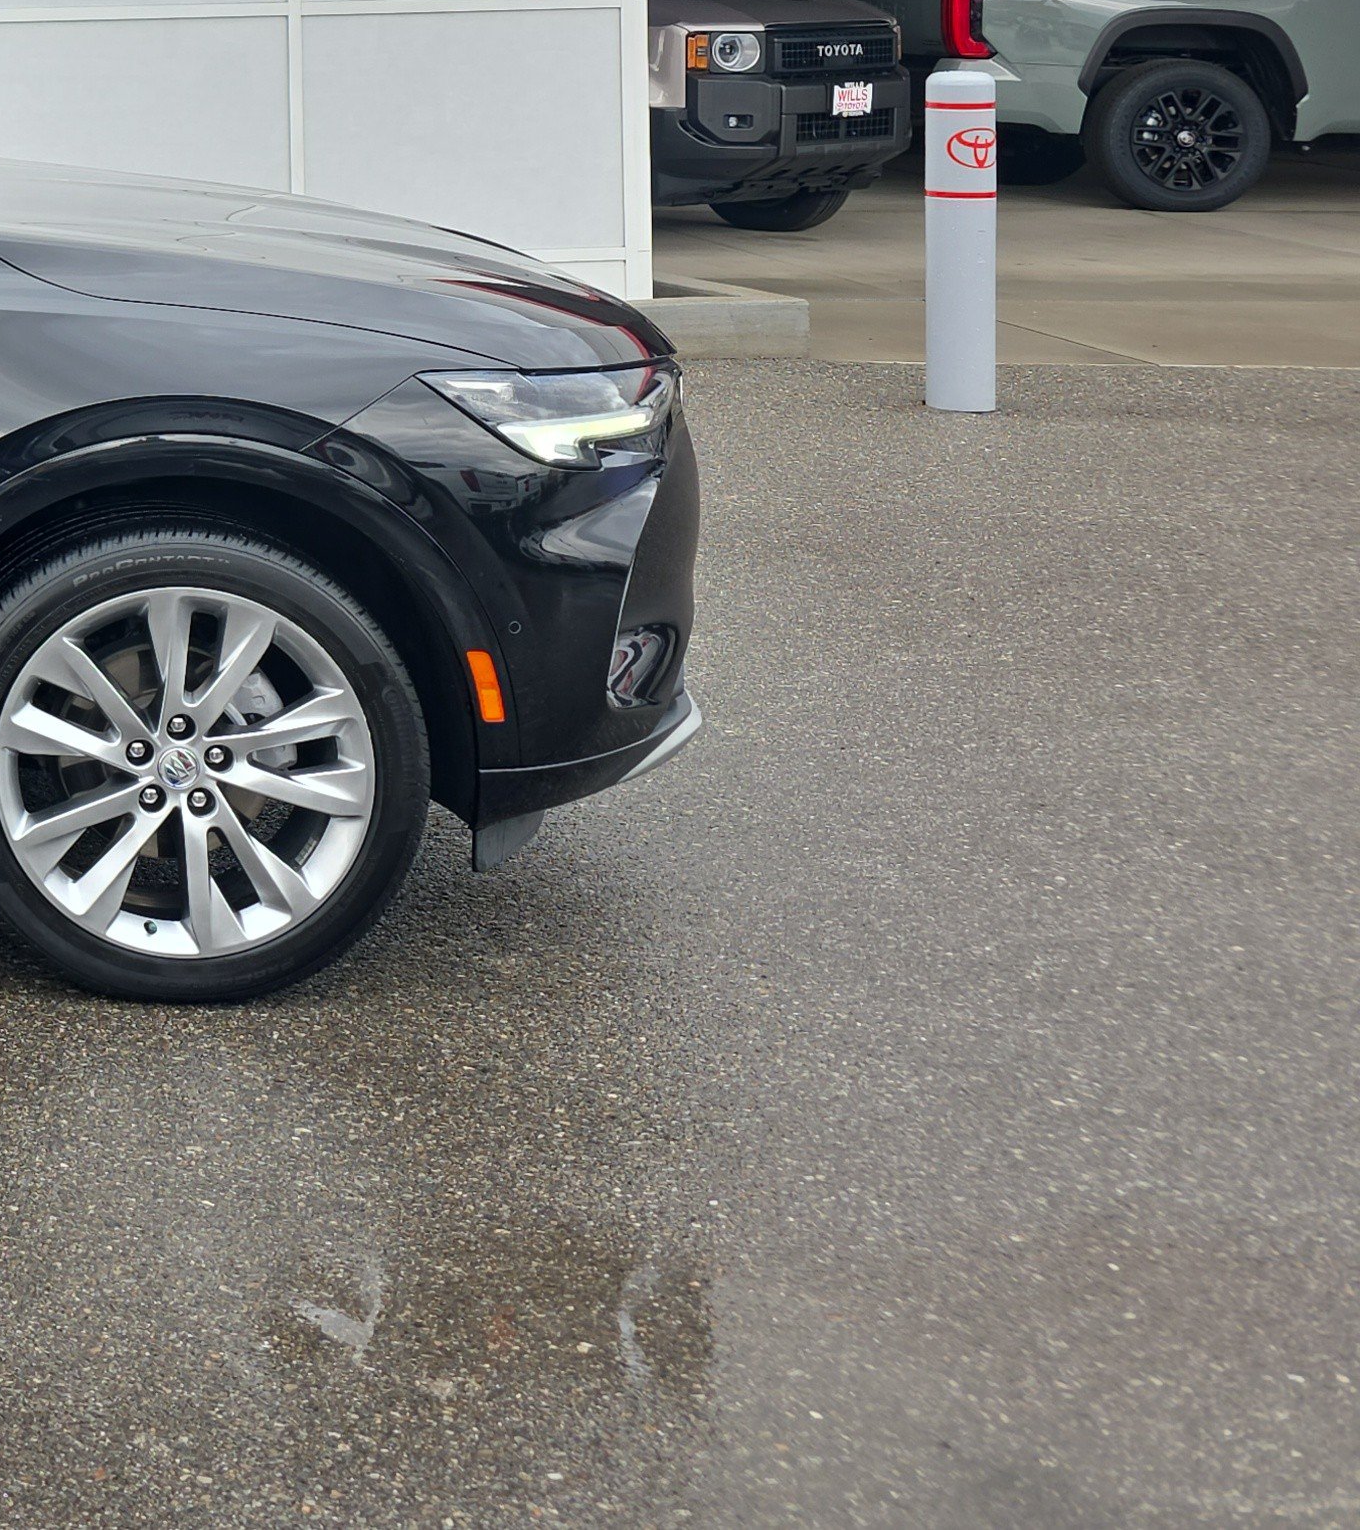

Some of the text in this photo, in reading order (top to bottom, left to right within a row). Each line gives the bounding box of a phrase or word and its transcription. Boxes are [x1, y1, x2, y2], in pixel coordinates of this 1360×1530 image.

[817, 43, 864, 57] TOYOTA
[837, 89, 868, 102] WILLS
[844, 102, 868, 110] TOYOTA
